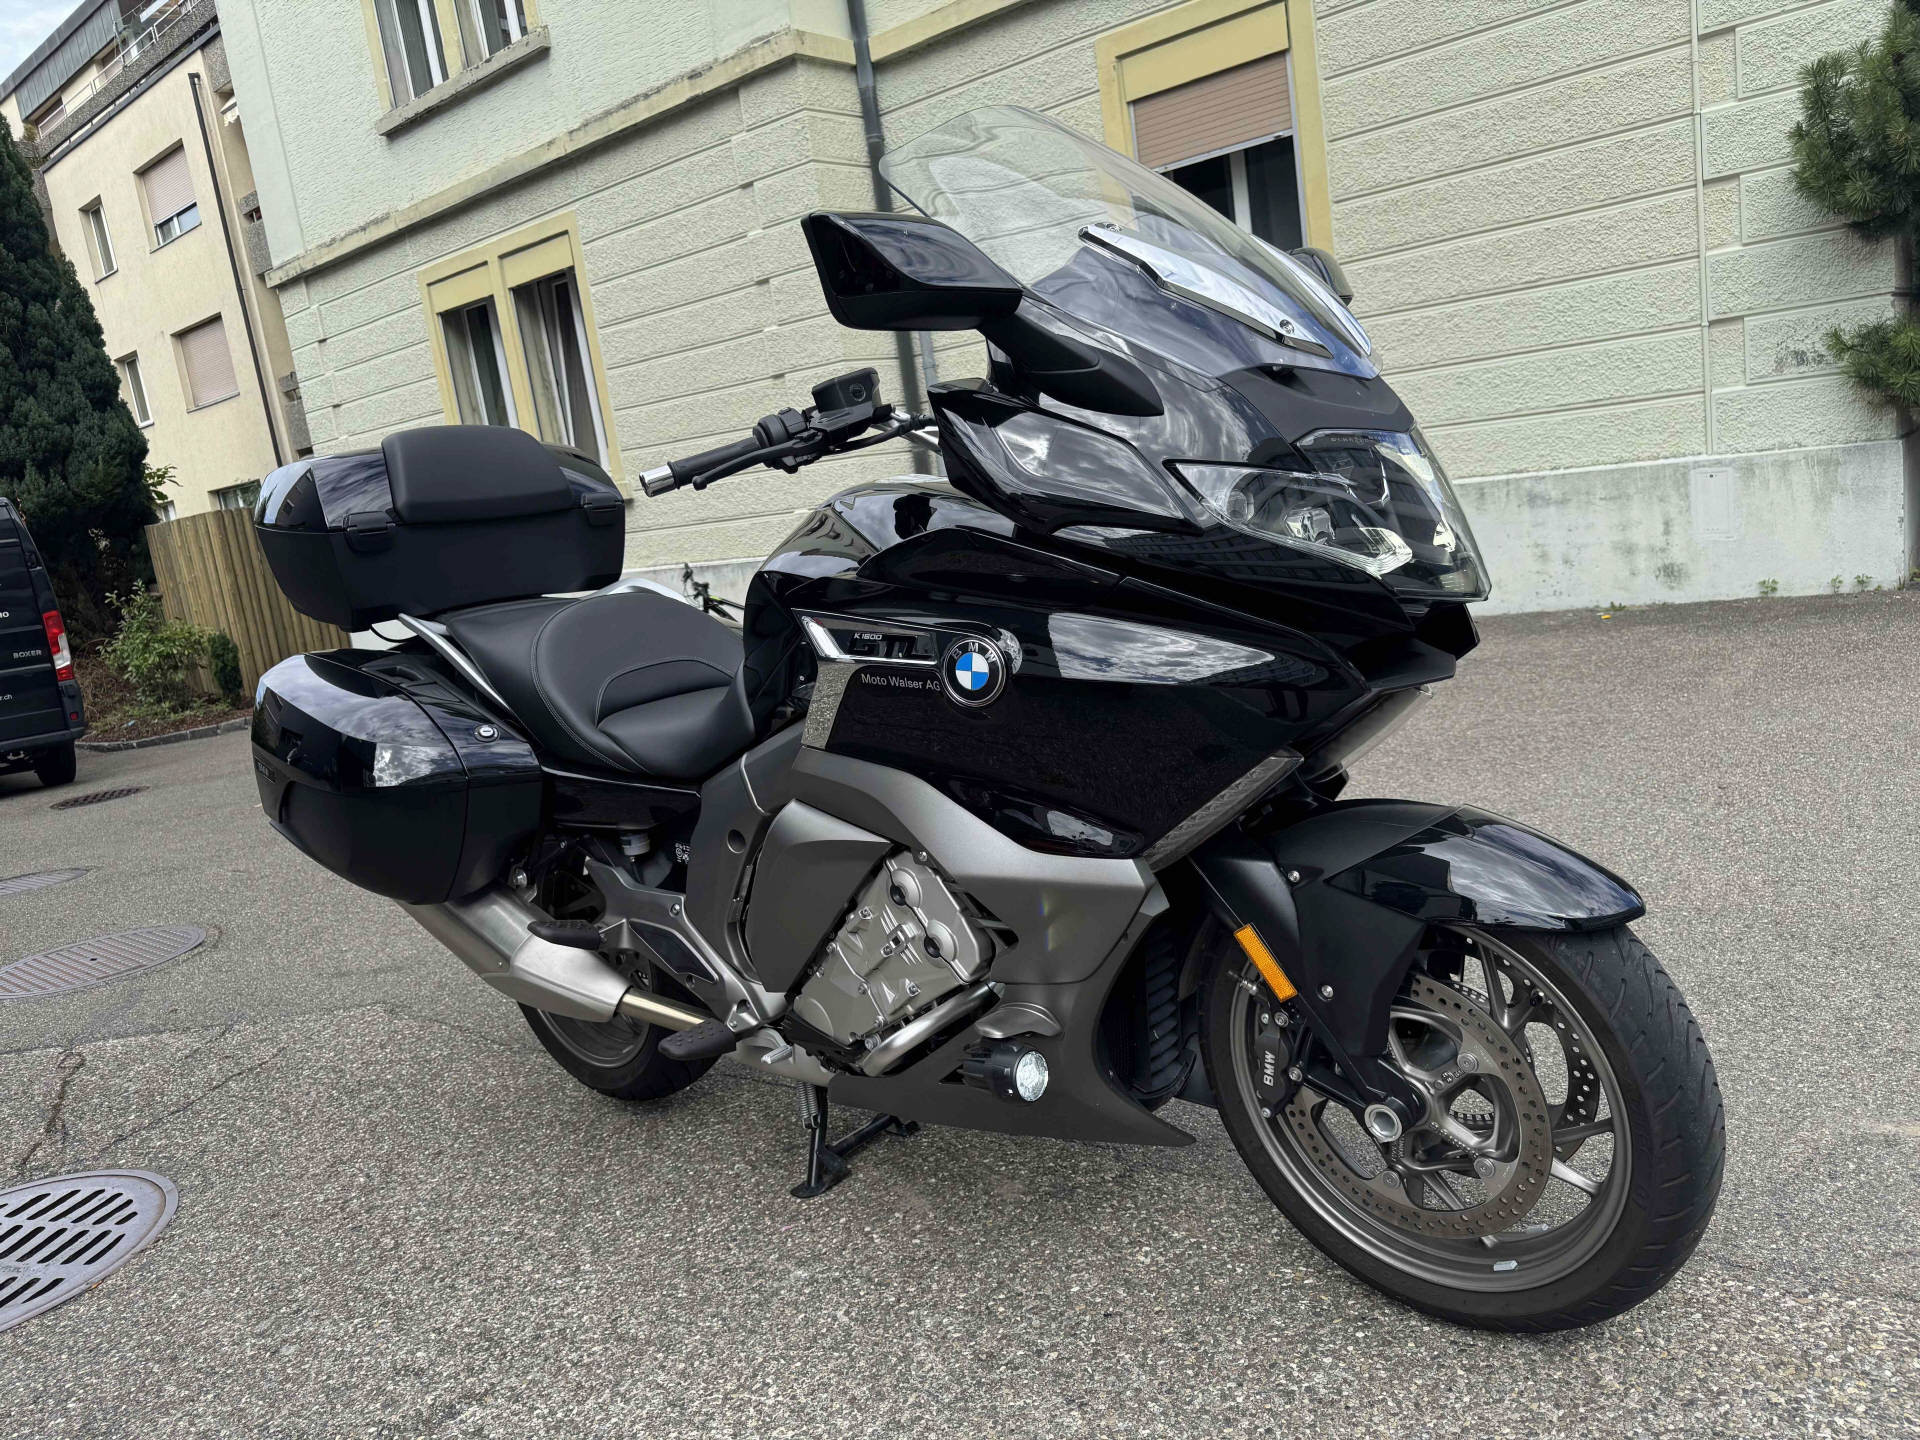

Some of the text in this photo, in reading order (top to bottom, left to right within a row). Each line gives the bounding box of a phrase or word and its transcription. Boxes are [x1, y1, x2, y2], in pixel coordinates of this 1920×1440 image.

[13, 649, 42, 659] BOXER
[951, 642, 997, 663] BMW
[861, 673, 941, 691] Moto Walser AG
[1263, 1050, 1276, 1087] BMW
